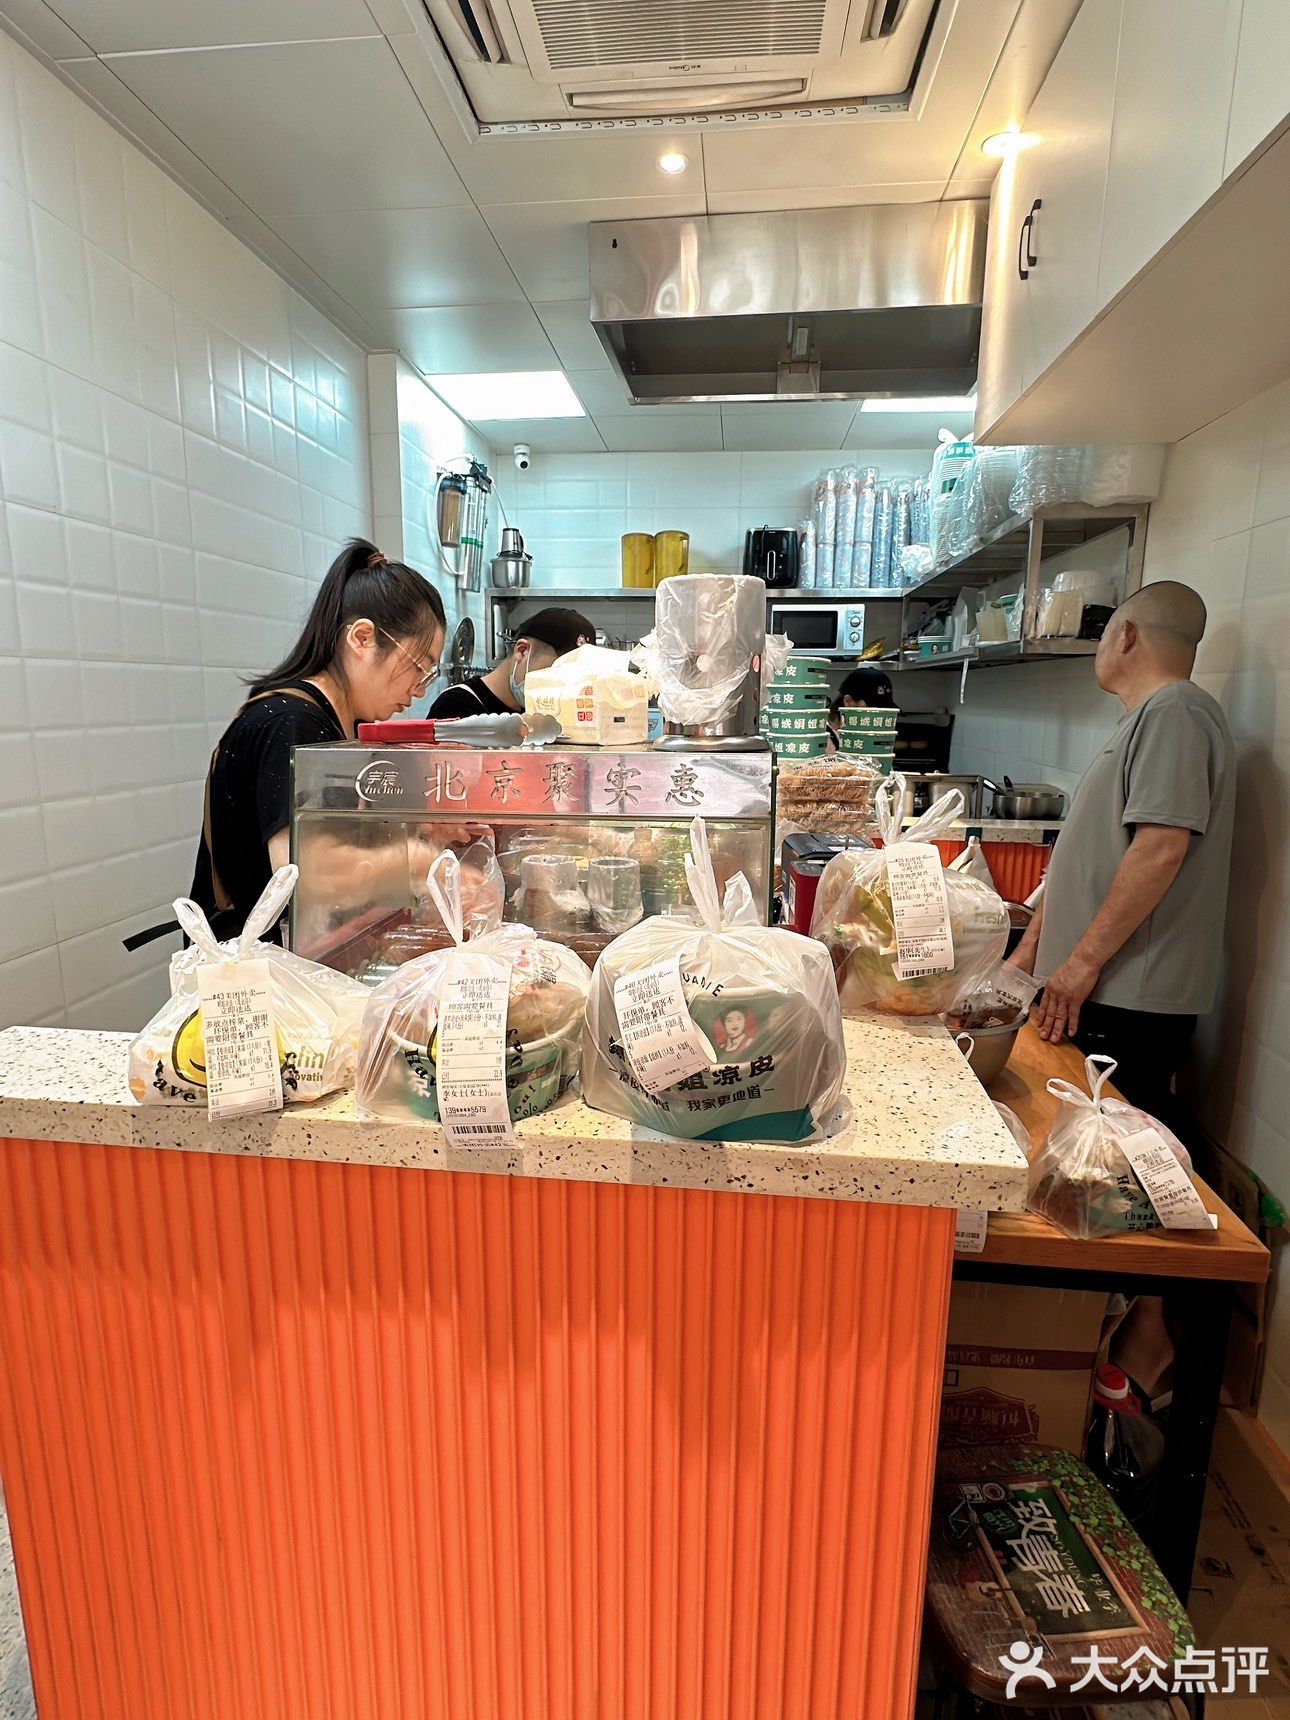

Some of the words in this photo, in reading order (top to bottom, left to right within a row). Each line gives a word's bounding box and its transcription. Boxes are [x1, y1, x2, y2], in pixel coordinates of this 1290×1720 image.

[423, 760, 704, 806] 北京聚实惠
